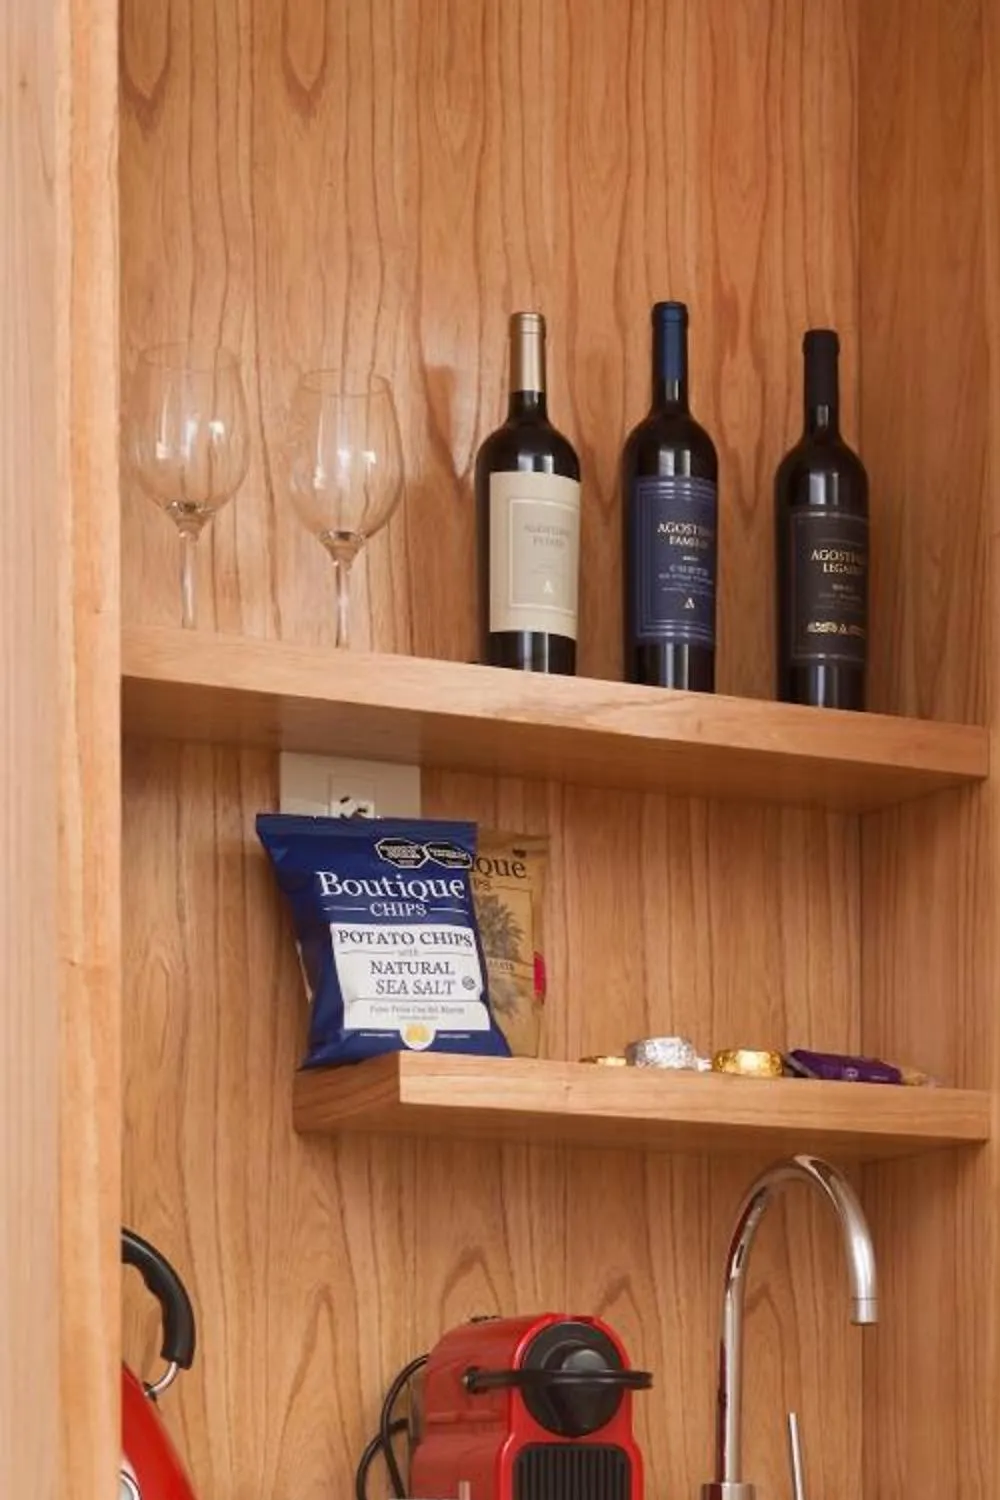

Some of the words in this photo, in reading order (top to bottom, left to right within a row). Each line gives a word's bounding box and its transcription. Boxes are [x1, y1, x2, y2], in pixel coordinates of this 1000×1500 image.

[471, 856, 528, 879] ique
[315, 871, 465, 902] Boutique
[369, 901, 427, 917] CHIPS
[338, 930, 415, 945] POTATO
[419, 931, 473, 947] CHIPS
[370, 960, 456, 976] NATURAL
[375, 979, 409, 995] SEA
[412, 979, 456, 996] SALT
